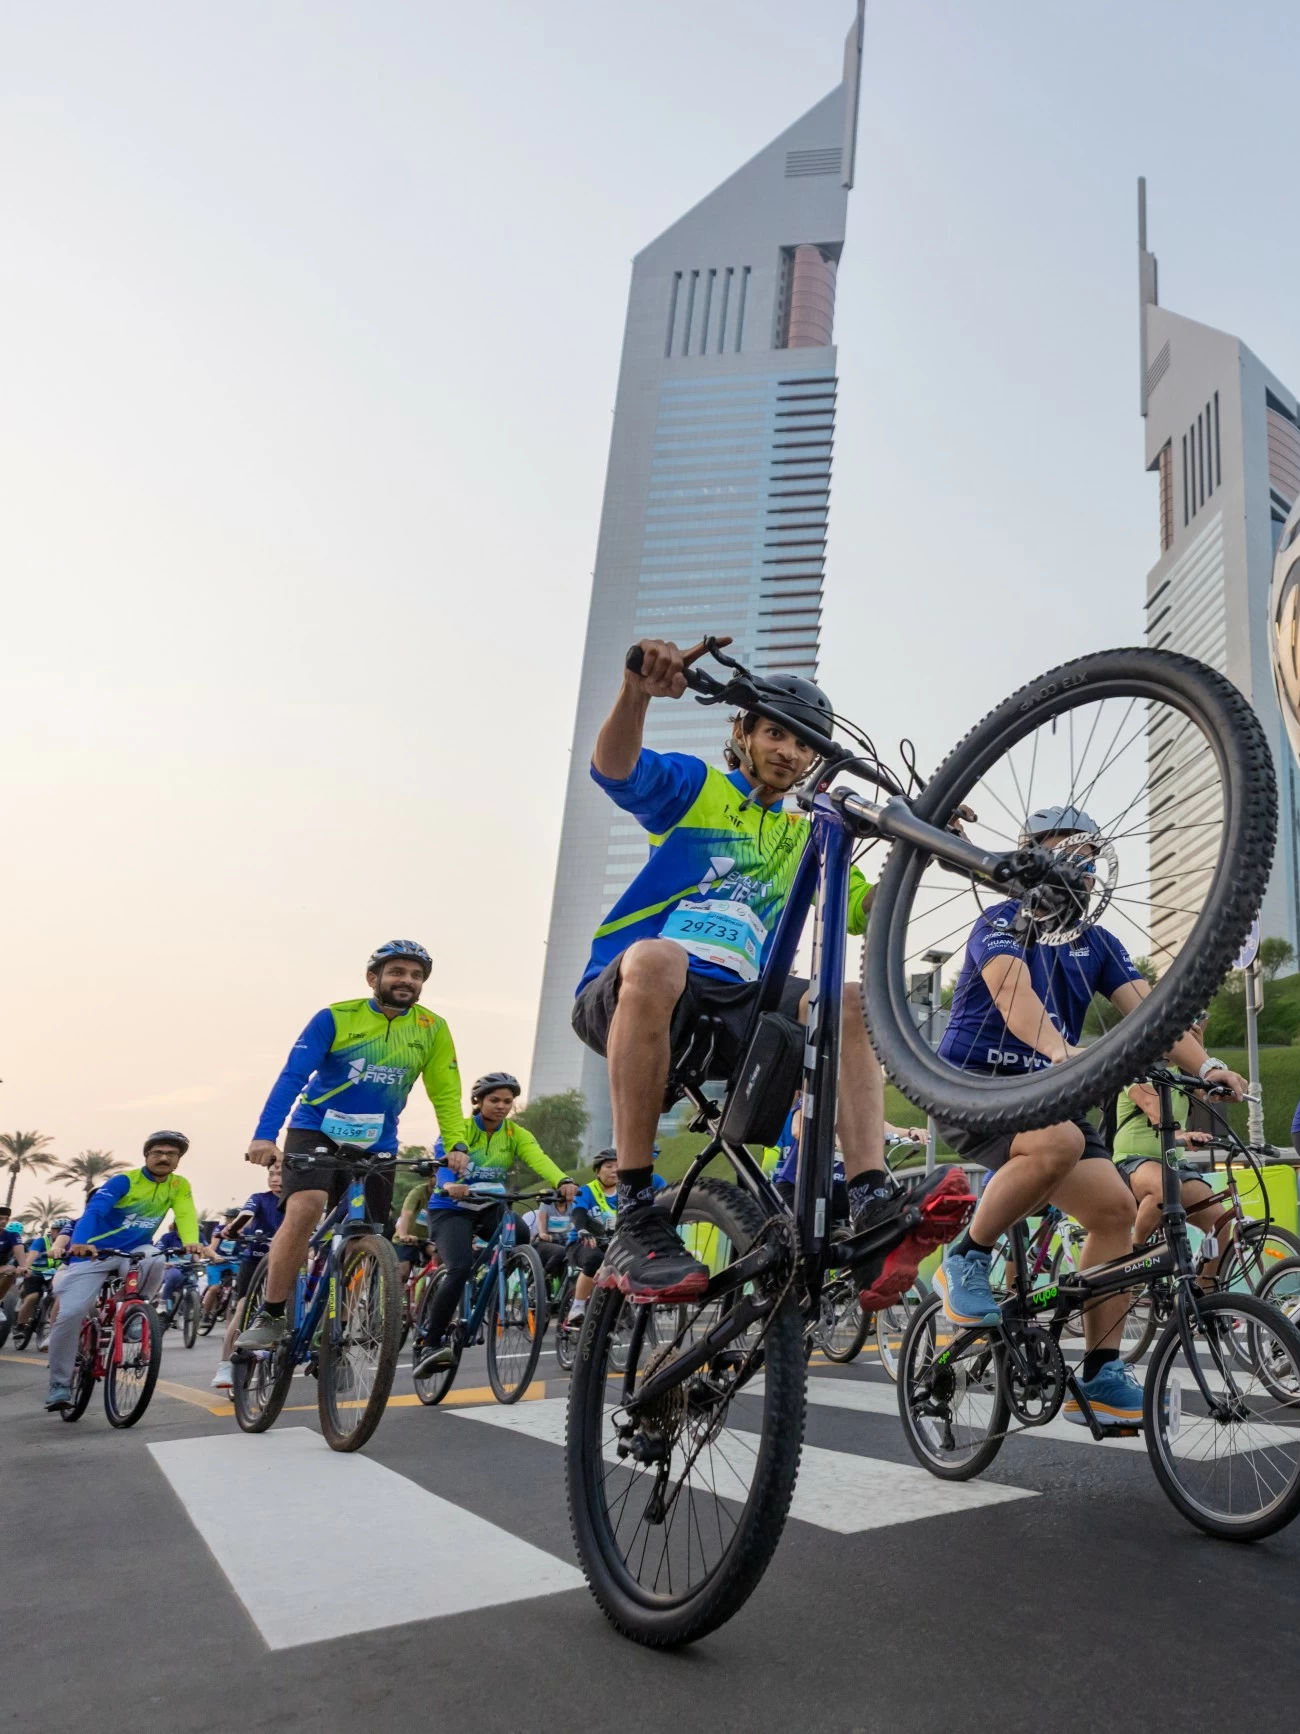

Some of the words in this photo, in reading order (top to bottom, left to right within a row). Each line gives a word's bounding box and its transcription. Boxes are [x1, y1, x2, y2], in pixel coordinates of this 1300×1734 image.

[1021, 683, 1058, 711] COMP
[680, 919, 739, 942] 29733
[986, 1048, 1019, 1066] DP
[362, 1071, 406, 1086] FIRST
[366, 1064, 409, 1075] EMIRATES
[329, 1125, 363, 1138] 11459
[132, 1220, 158, 1230] FIRS
[1124, 1256, 1161, 1274] DAHON
[1032, 1287, 1058, 1308] vybe
[582, 1320, 598, 1361] COMP
